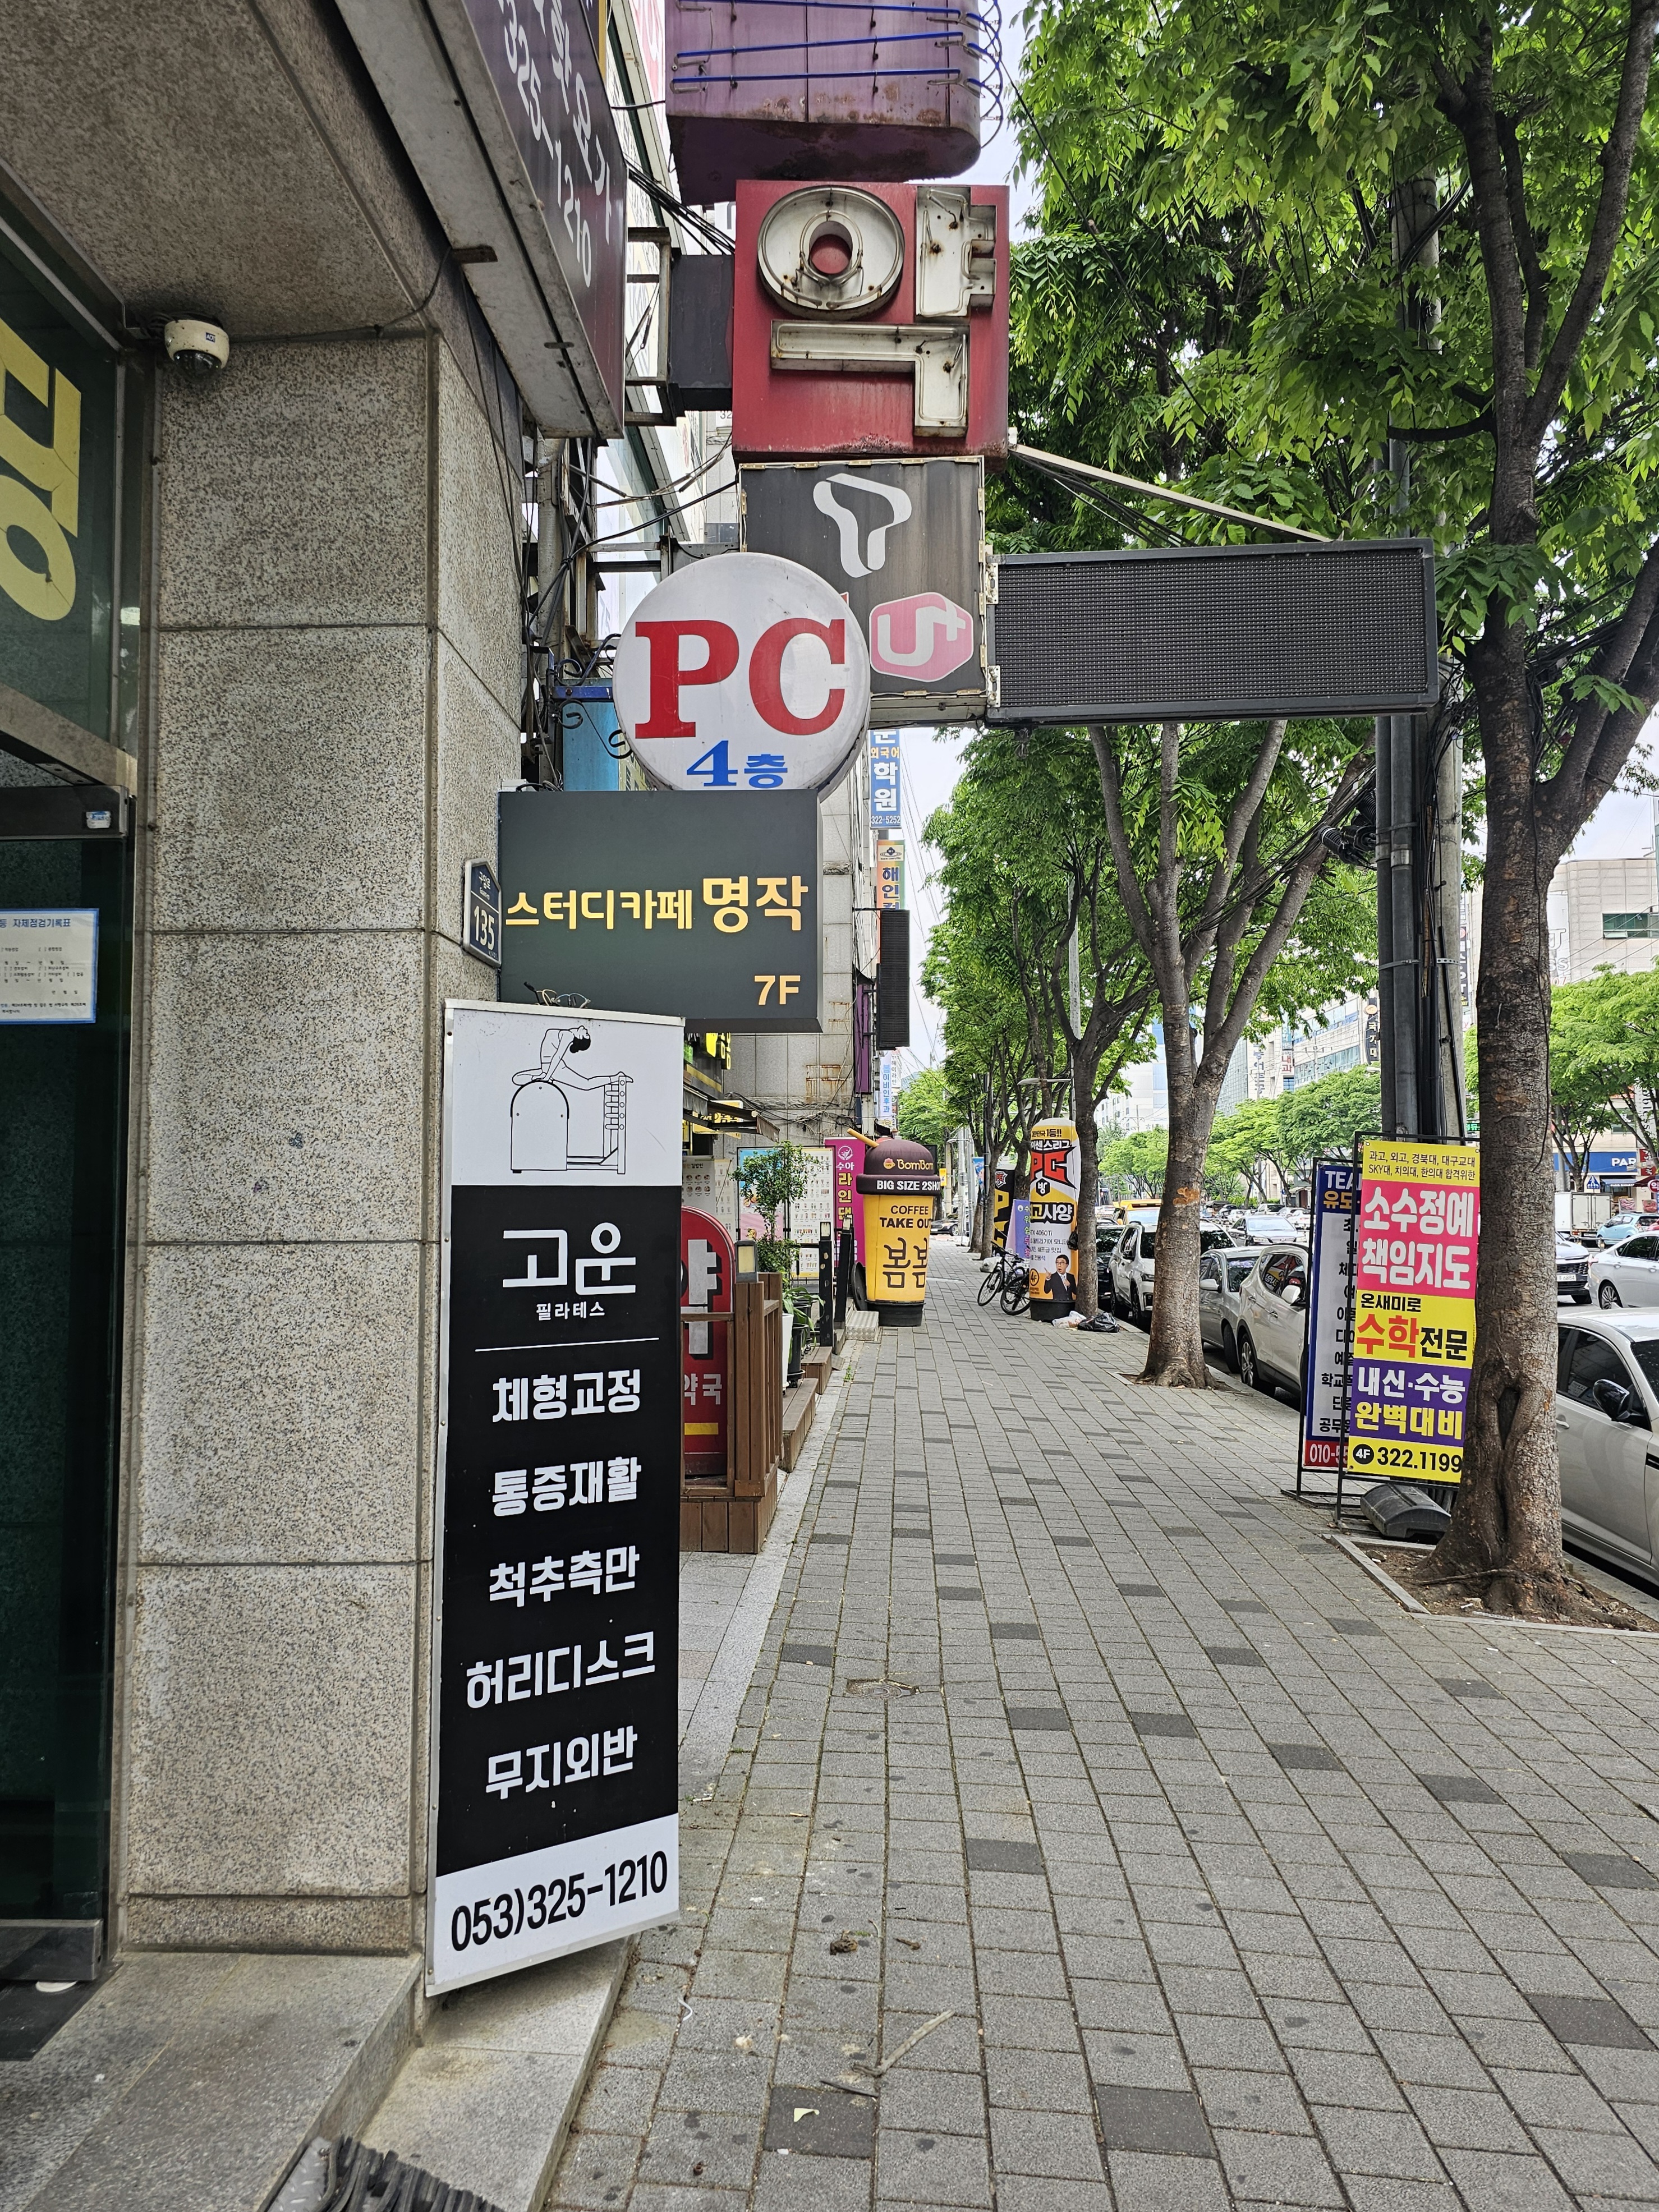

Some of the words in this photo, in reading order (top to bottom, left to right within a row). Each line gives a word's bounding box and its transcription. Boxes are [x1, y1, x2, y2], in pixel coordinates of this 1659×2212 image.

[758, 185, 996, 438] 약
[634, 617, 847, 739] PC
[686, 740, 788, 789] 4층
[871, 747, 899, 758] 외국어
[874, 762, 898, 811] 학원
[871, 815, 900, 824] 322-5252
[505, 889, 692, 930] 스터디카페
[702, 875, 808, 933] 명작
[474, 905, 495, 950] 135
[754, 974, 801, 1006] 7F
[1031, 1139, 1070, 1151] 이센스리그
[1046, 1129, 1061, 1137] 1등!!
[836, 1162, 854, 1170] 수아
[1368, 1165, 1393, 1176] SKY대,
[1395, 1166, 1419, 1178] 치의대,
[1421, 1167, 1443, 1179] 한의대
[1445, 1169, 1476, 1181] 합격위한
[1370, 1151, 1388, 1163] 과고,
[1390, 1152, 1409, 1164] 외고,
[1412, 1153, 1439, 1166] 경북대,
[1442, 1155, 1476, 1168] 대구교대
[838, 1173, 852, 1236] 라인댄
[877, 1180, 894, 1190] BIG
[897, 1181, 920, 1190] SIZE
[1037, 1181, 1047, 1194] 방
[880, 1218, 913, 1228] TAKE
[891, 1206, 929, 1215] COFFEE
[1031, 1204, 1073, 1221] 고사양
[1364, 1187, 1474, 1238] 소수정예
[503, 1222, 636, 1295] 고운
[1362, 1238, 1470, 1290] 책임지도
[536, 1302, 605, 1321] 필라테스
[1361, 1293, 1422, 1313] 온새미로
[492, 1369, 641, 1423] 체형교정
[1354, 1401, 1463, 1440] 완벽대비
[1355, 1448, 1371, 1459] 4F
[1377, 1446, 1462, 1473] 322.1199
[492, 1456, 641, 1517] 통증재활
[489, 1546, 640, 1608] 척추측만
[466, 1631, 655, 1709] 허리디스크
[486, 1725, 637, 1800] 무지외반
[451, 1850, 668, 1952] 053)325-1210
